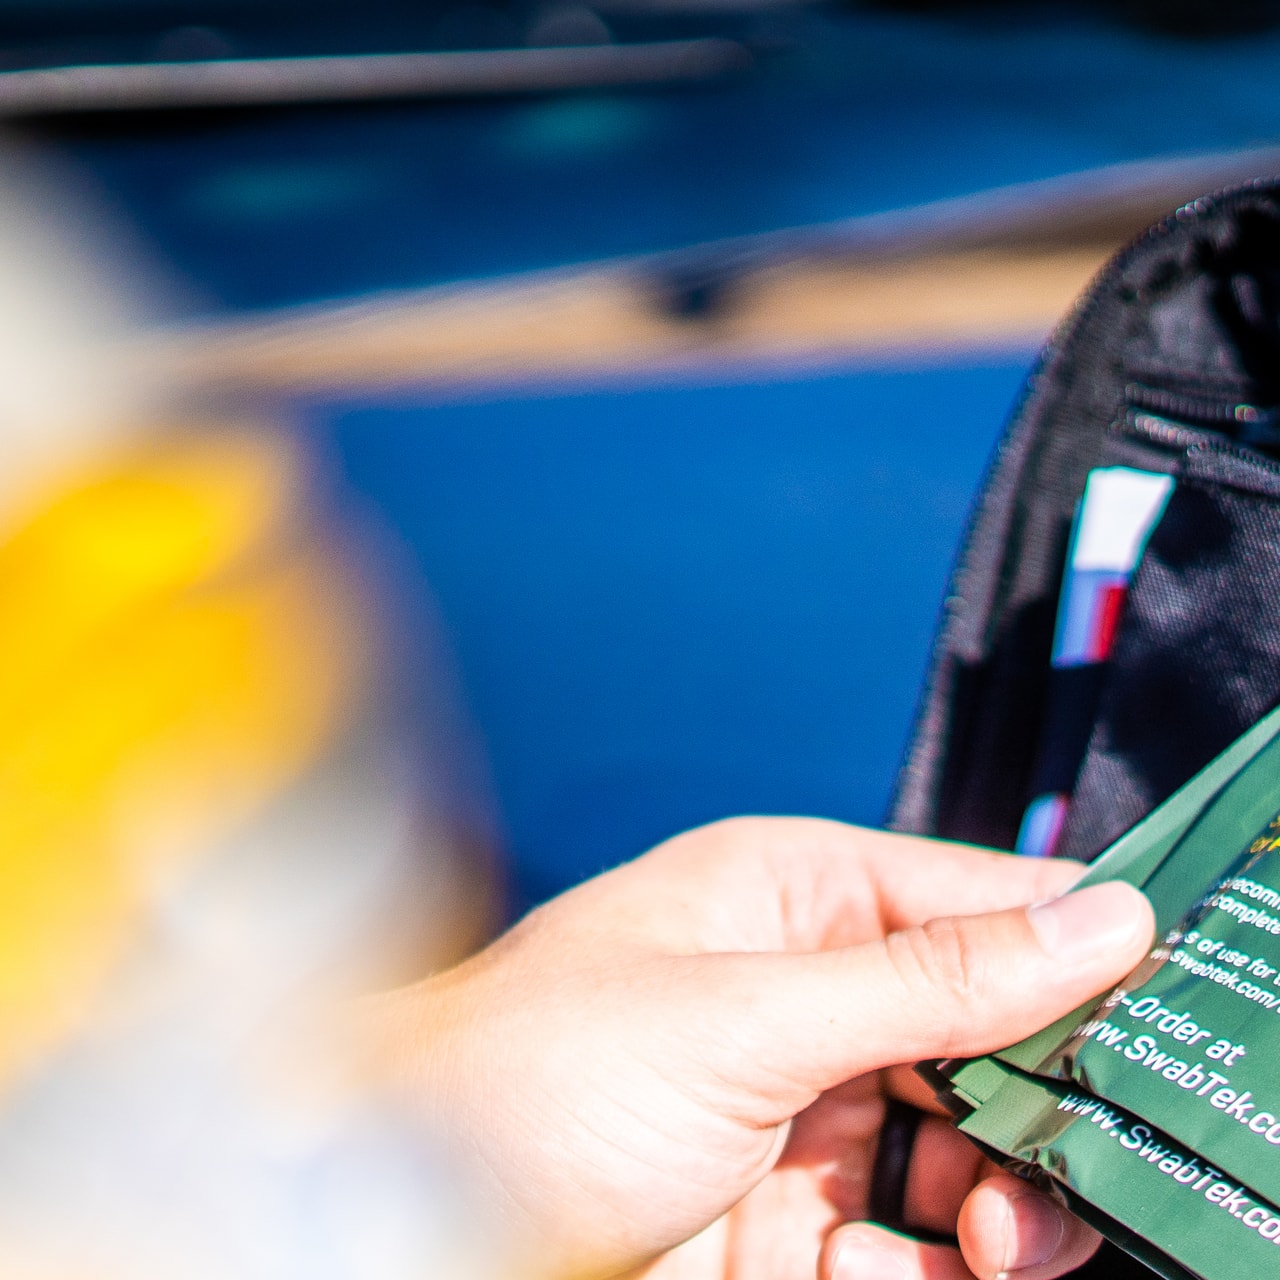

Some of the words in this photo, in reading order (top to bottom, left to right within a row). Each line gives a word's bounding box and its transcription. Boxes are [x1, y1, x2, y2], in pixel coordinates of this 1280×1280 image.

[1196, 939, 1225, 960] of
[1216, 949, 1250, 967] use
[1246, 959, 1277, 979] for
[1205, 1040, 1246, 1067] at
